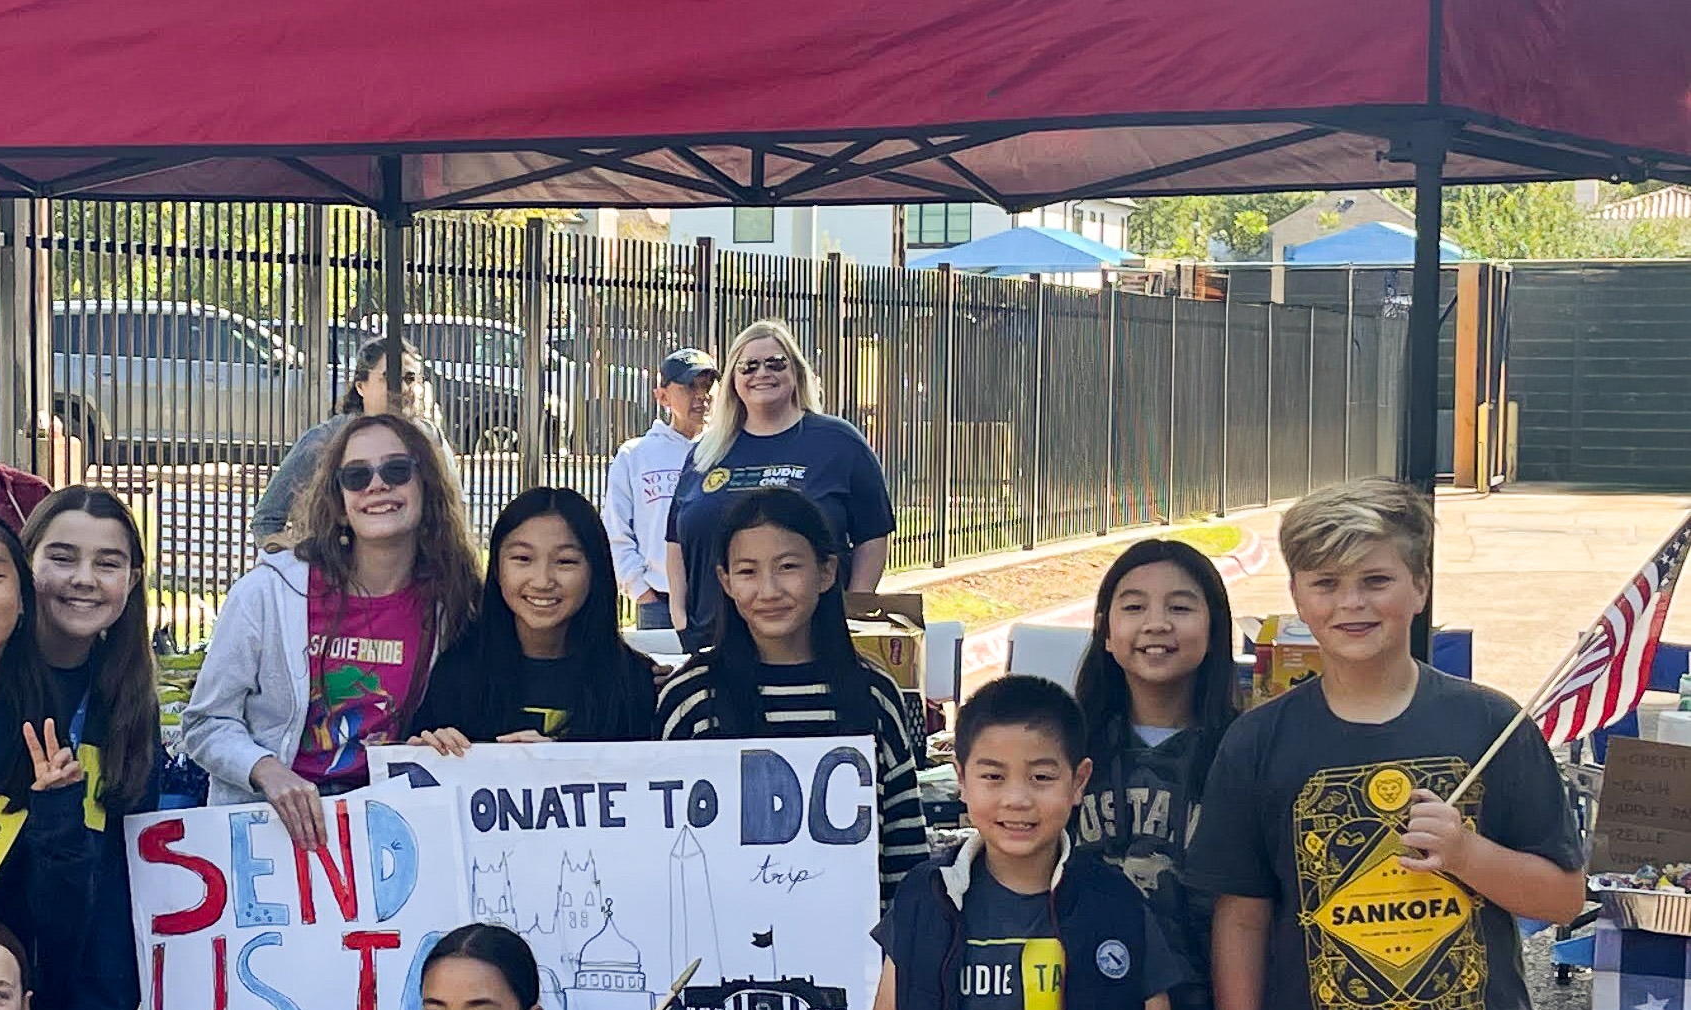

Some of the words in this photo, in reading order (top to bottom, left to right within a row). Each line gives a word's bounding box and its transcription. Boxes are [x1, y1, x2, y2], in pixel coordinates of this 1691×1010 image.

[649, 779, 719, 830] TO
[740, 746, 873, 846] DC
[138, 799, 419, 936] SEND
[750, 853, 824, 895] trip
[1331, 897, 1461, 926] SANKOFA
[960, 964, 1013, 995] UDIE
[1034, 964, 1062, 992] TA
